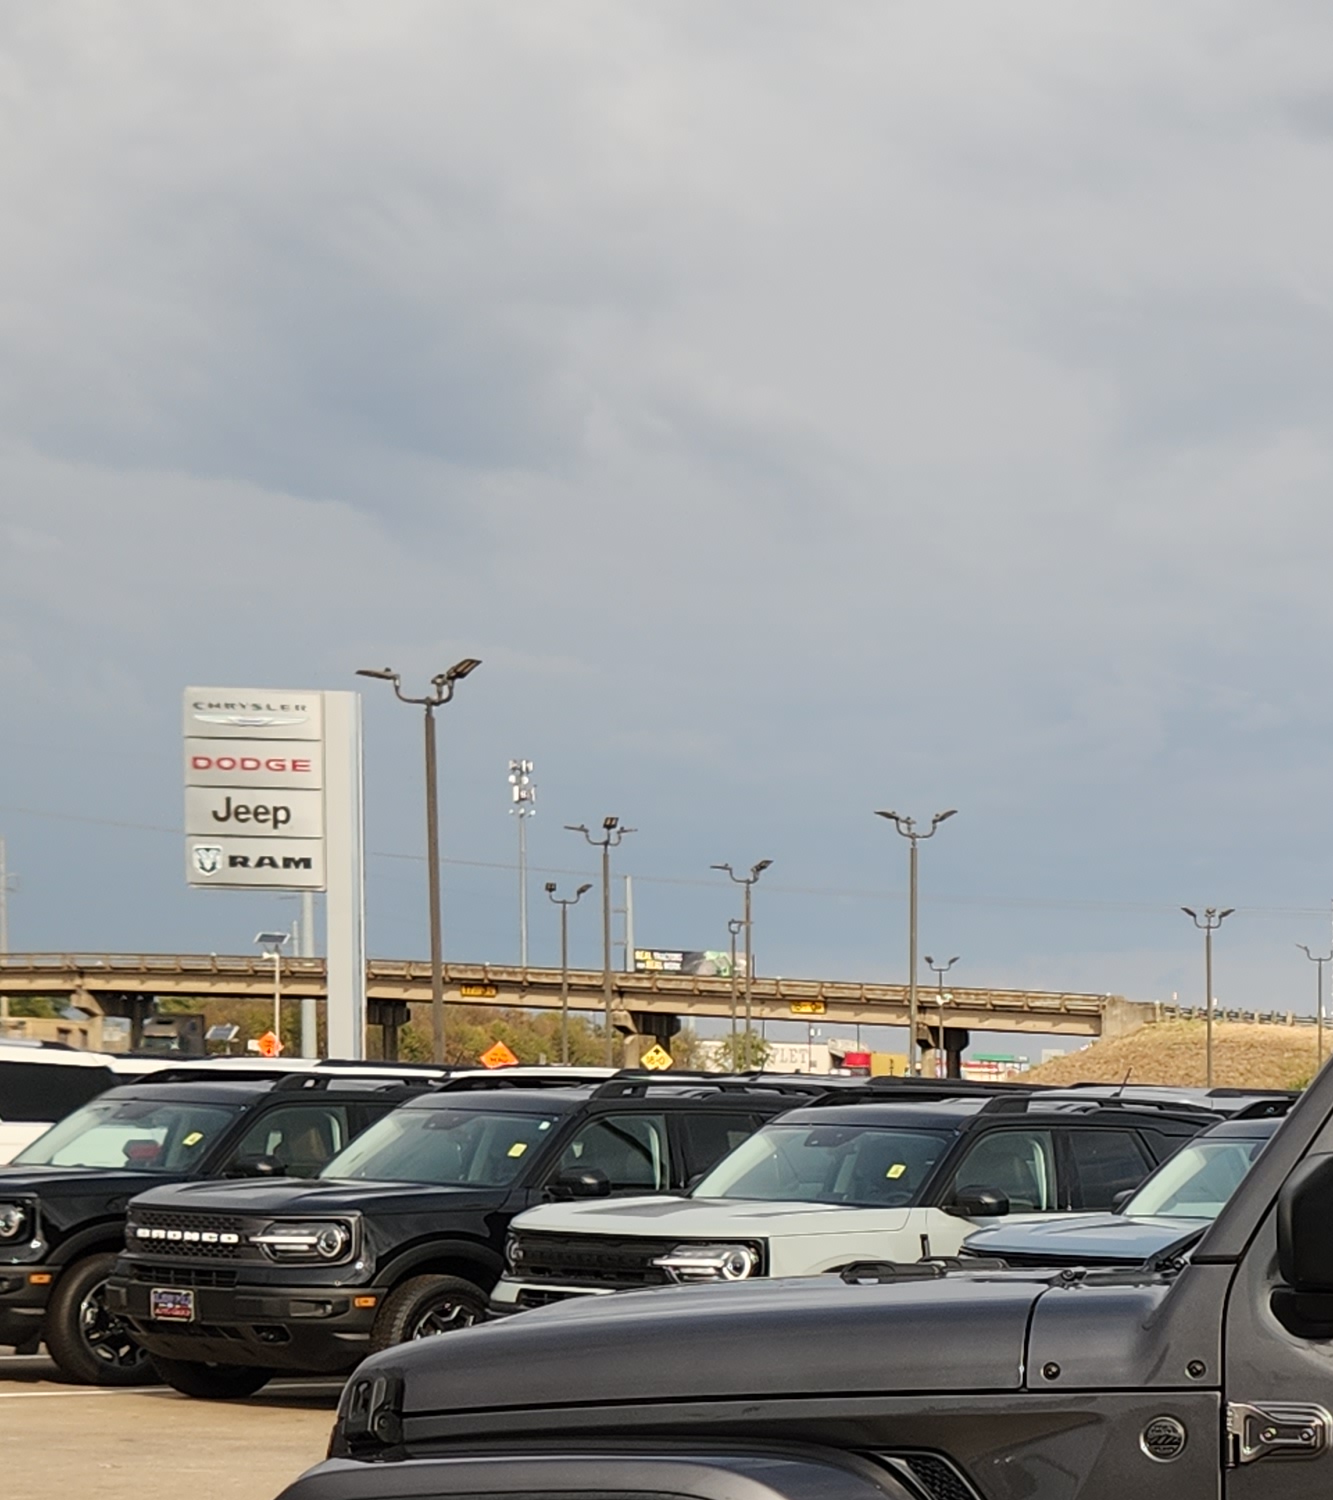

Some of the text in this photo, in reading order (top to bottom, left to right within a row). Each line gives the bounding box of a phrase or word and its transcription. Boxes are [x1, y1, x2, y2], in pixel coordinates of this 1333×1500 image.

[192, 701, 307, 712] CHRYSLER
[191, 756, 312, 773] DODGE
[212, 796, 291, 829] Jeep
[228, 854, 313, 869] RAM
[136, 1228, 239, 1243] BRONCO
